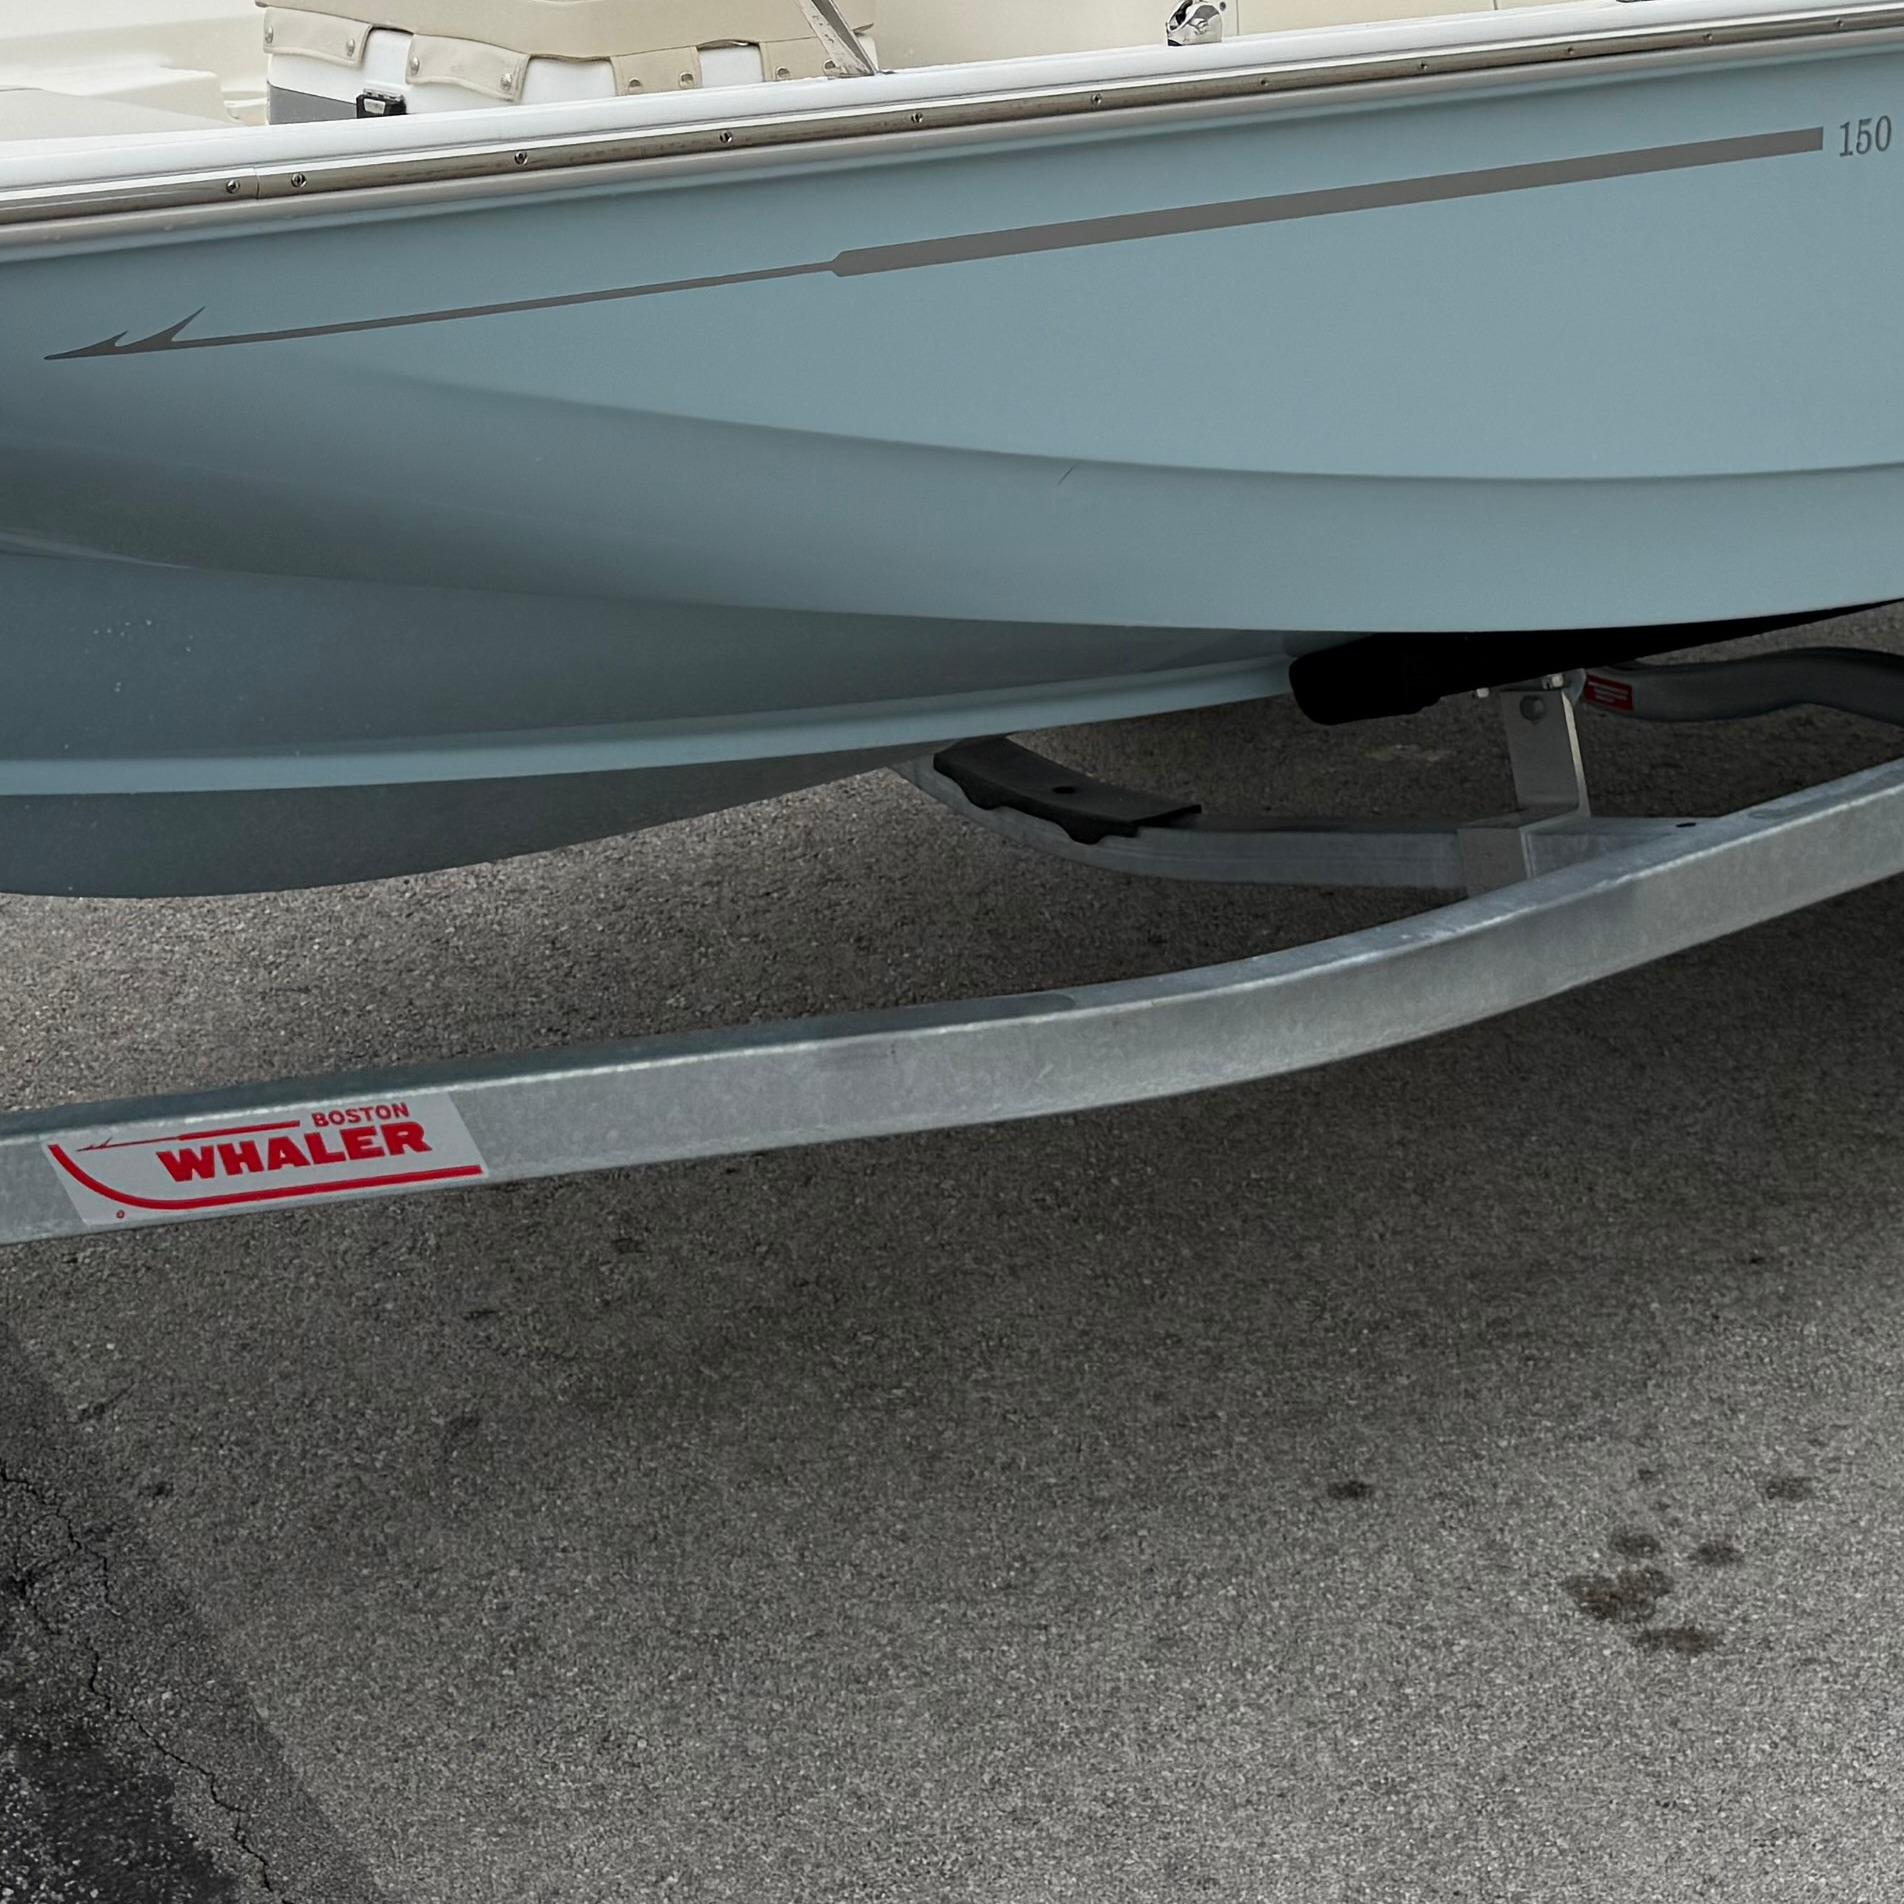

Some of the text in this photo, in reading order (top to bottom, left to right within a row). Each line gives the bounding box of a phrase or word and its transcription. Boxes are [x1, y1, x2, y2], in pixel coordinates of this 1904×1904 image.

[1839, 115, 1892, 157] 150
[311, 1102, 410, 1127] BOSTON
[156, 1121, 433, 1182] WHALER
